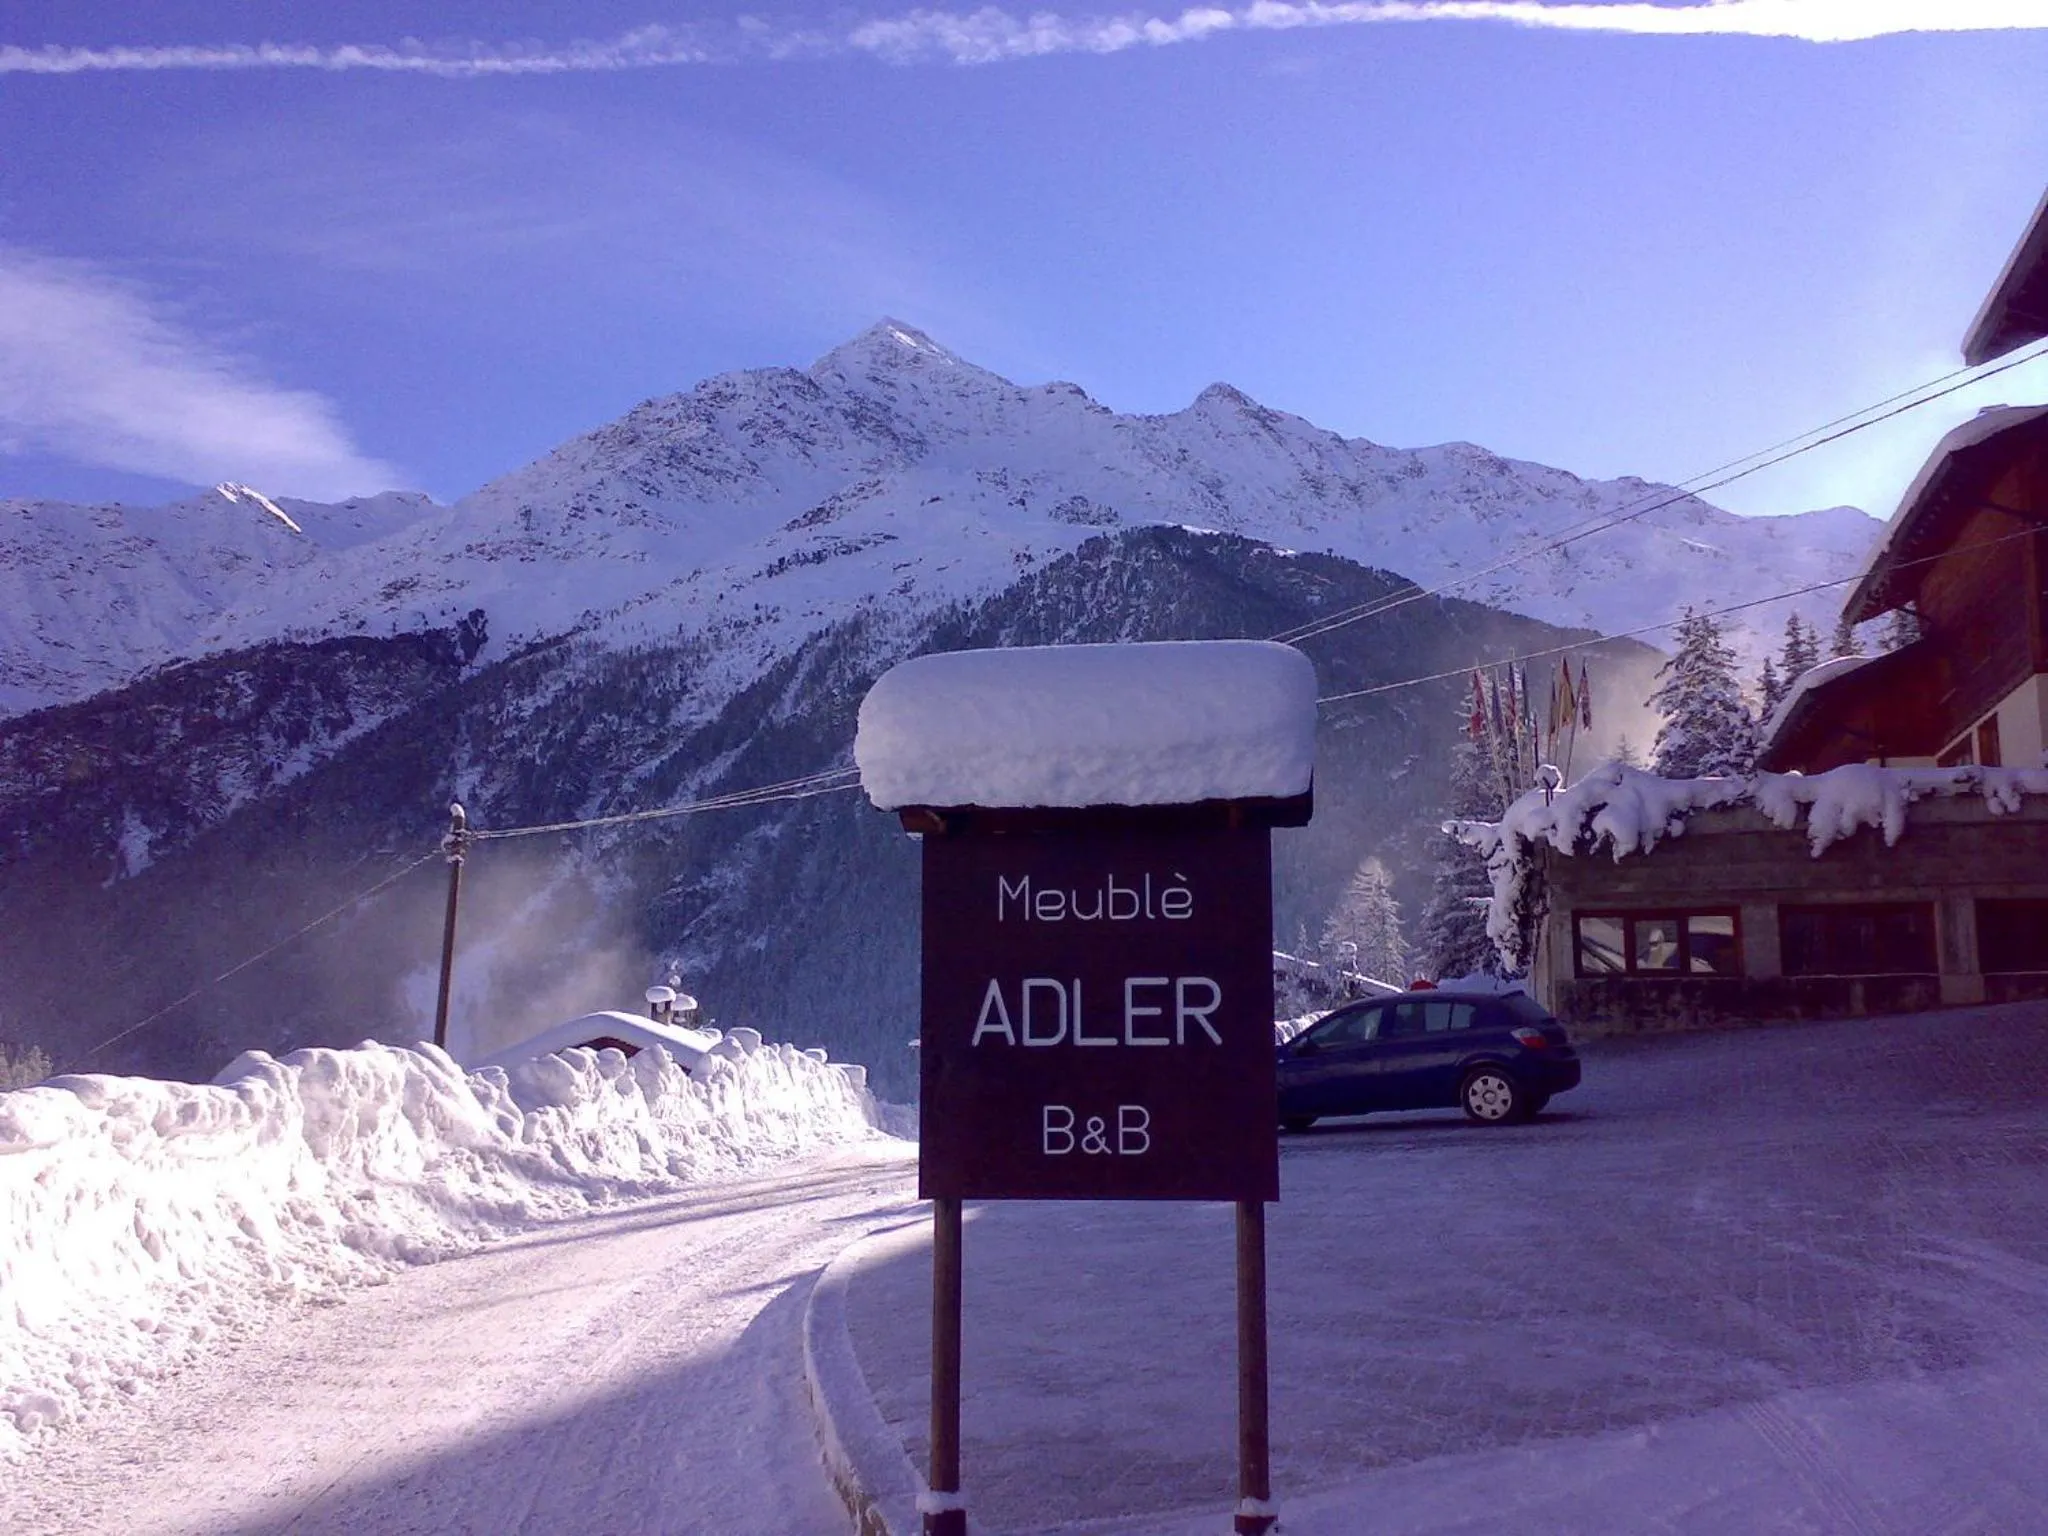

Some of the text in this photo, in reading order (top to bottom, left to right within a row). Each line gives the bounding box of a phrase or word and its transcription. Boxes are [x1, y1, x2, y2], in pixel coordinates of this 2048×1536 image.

[998, 873, 1193, 921] Meublè
[972, 977, 1222, 1047] ADLER
[1043, 1105, 1151, 1155] B&B
